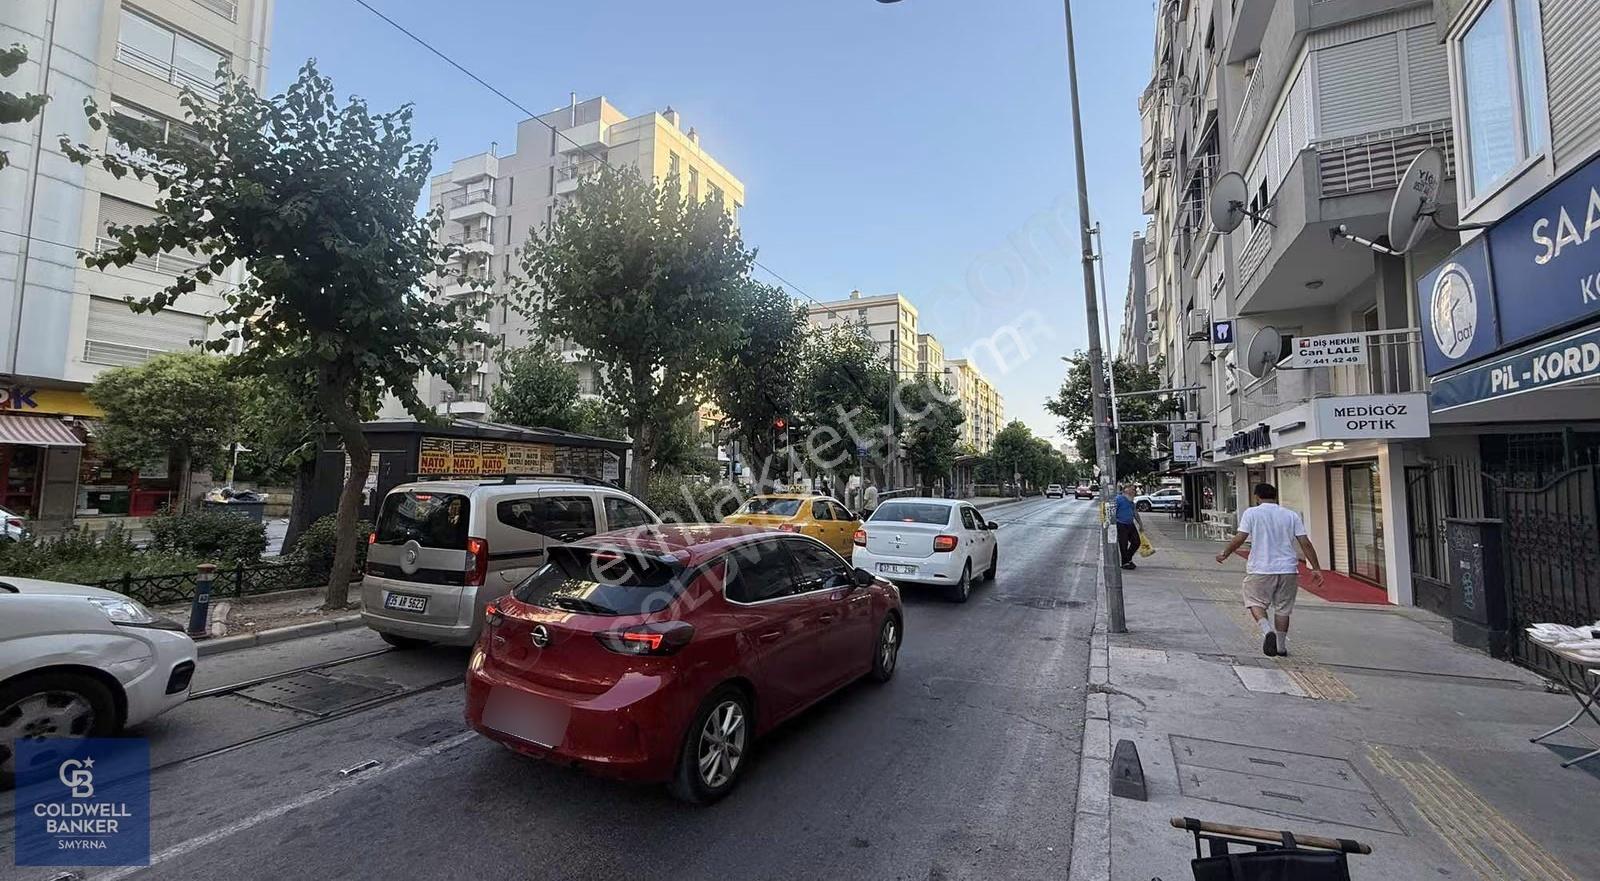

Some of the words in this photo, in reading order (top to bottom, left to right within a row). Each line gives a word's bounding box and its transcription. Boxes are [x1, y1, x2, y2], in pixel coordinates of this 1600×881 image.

[1581, 272, 1600, 304] K
[1299, 349, 1323, 357] Can
[1327, 346, 1360, 355] LALE
[1334, 403, 1407, 417] MEDİGÖZ
[1346, 419, 1396, 431] OPTİK
[421, 457, 445, 468] NATO
[453, 458, 475, 468] NATO
[482, 459, 502, 469] NATO
